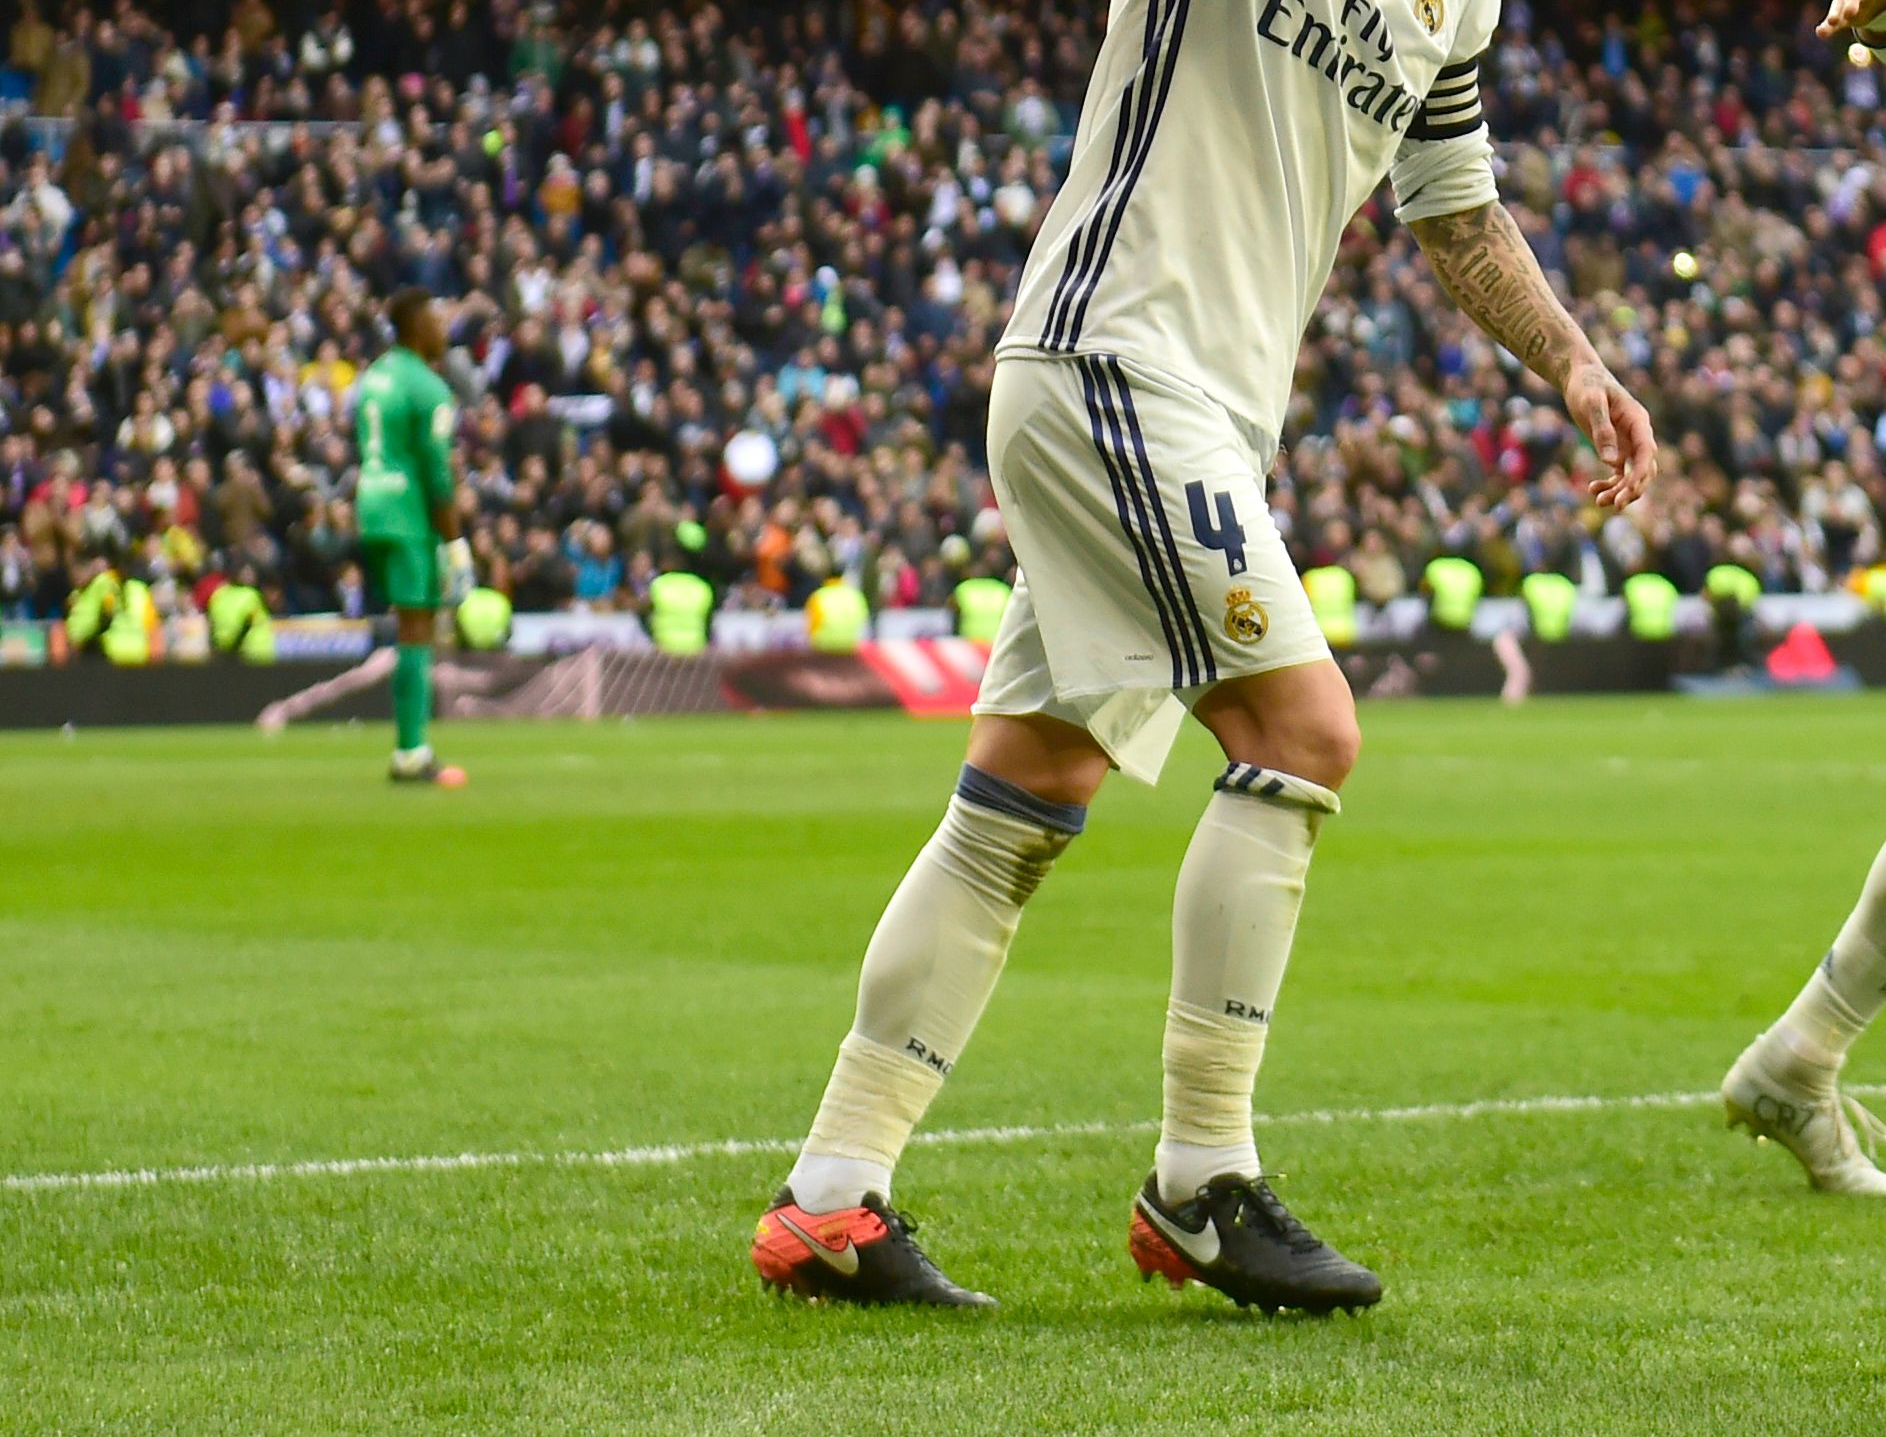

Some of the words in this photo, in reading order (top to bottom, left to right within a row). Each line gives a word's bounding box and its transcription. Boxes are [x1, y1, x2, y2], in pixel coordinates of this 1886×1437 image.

[1184, 478, 1248, 577] 4
[1225, 999, 1270, 1022] RM
[1753, 1093, 1816, 1137] CR7
